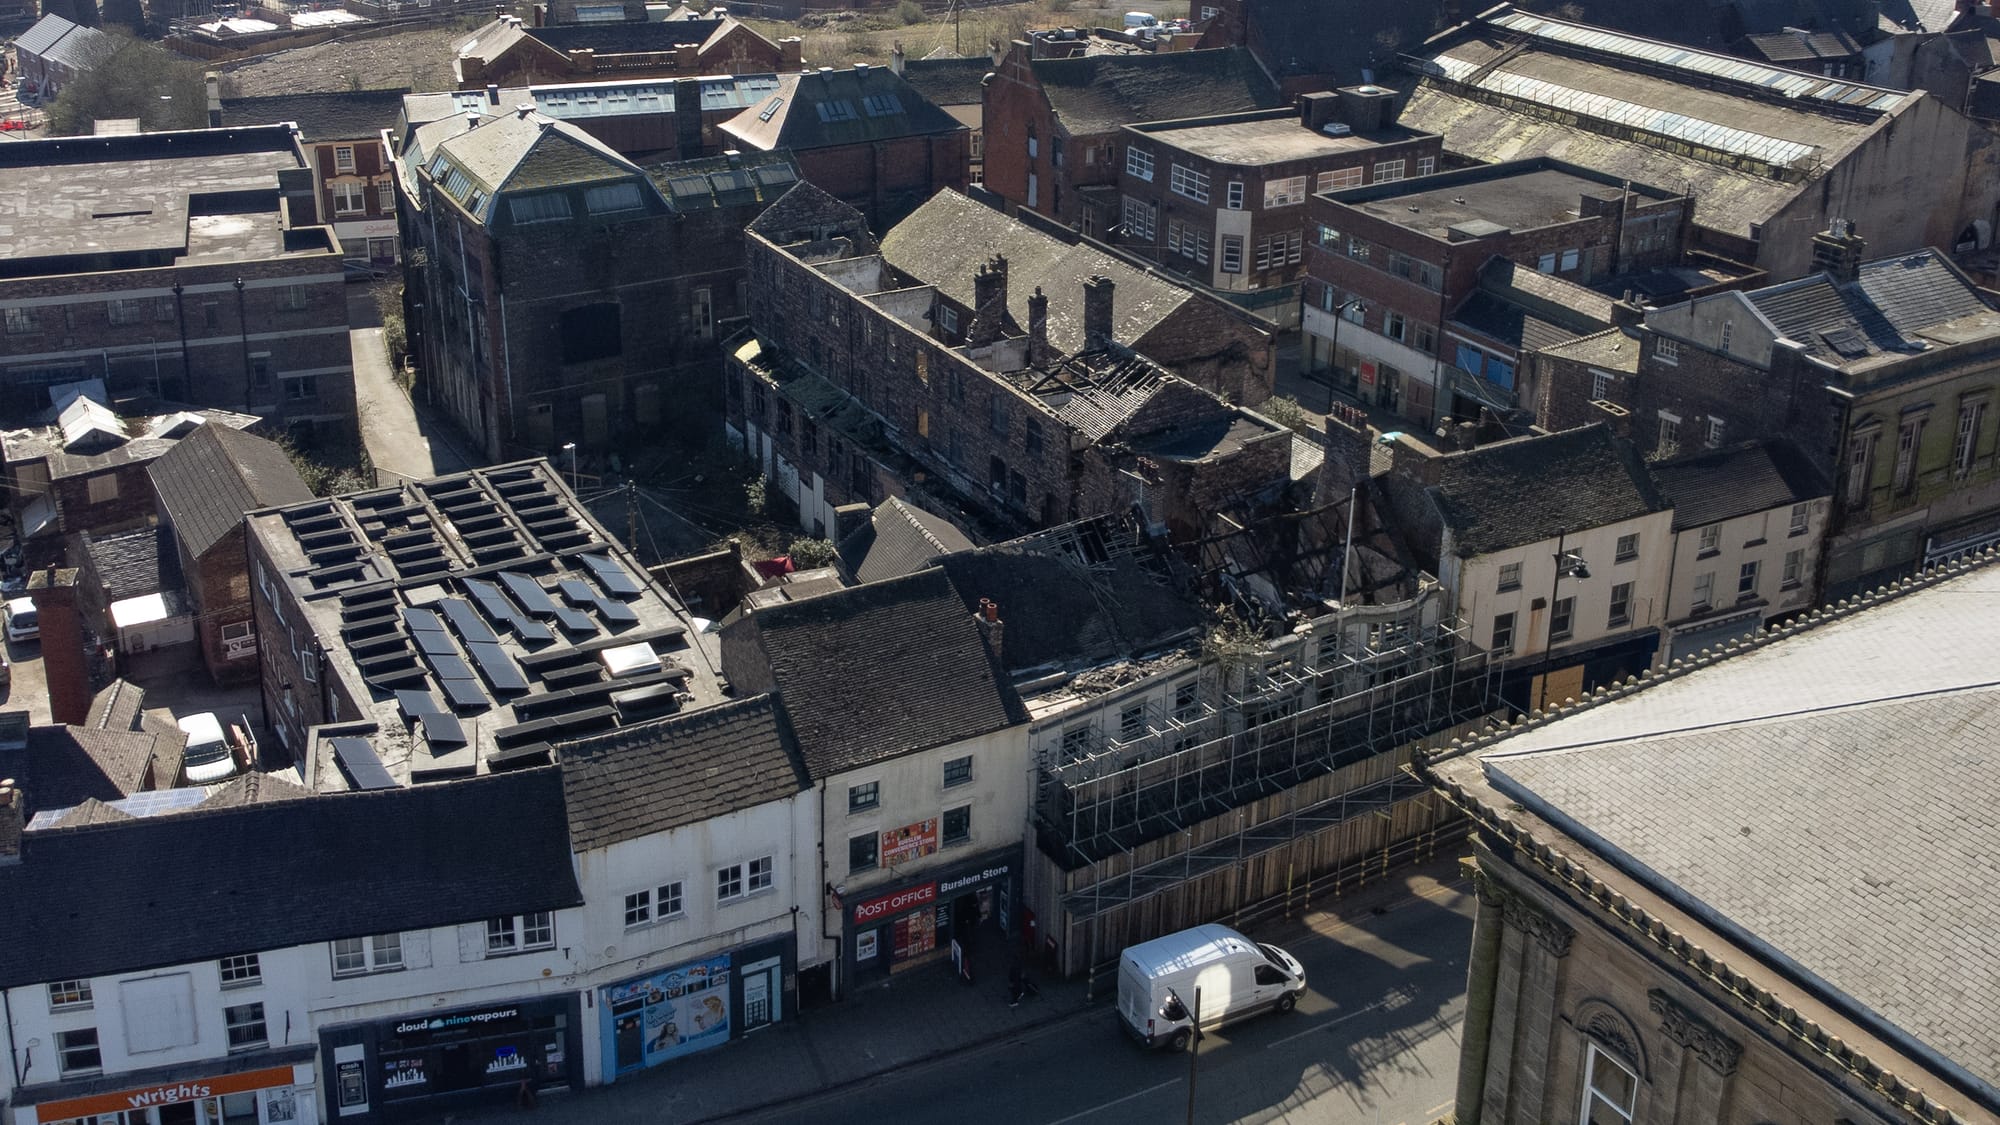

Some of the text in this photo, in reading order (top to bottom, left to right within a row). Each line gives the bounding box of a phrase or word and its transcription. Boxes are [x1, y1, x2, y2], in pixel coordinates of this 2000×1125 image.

[884, 836, 936, 856] CONVENIENCE STORE
[898, 834, 922, 846] BURSLEM
[941, 866, 1008, 893] Burslem Store
[856, 901, 887, 918] POST
[891, 887, 933, 911] OFFICE
[396, 1019, 428, 1033] cloud
[128, 1084, 211, 1108] Wrights
